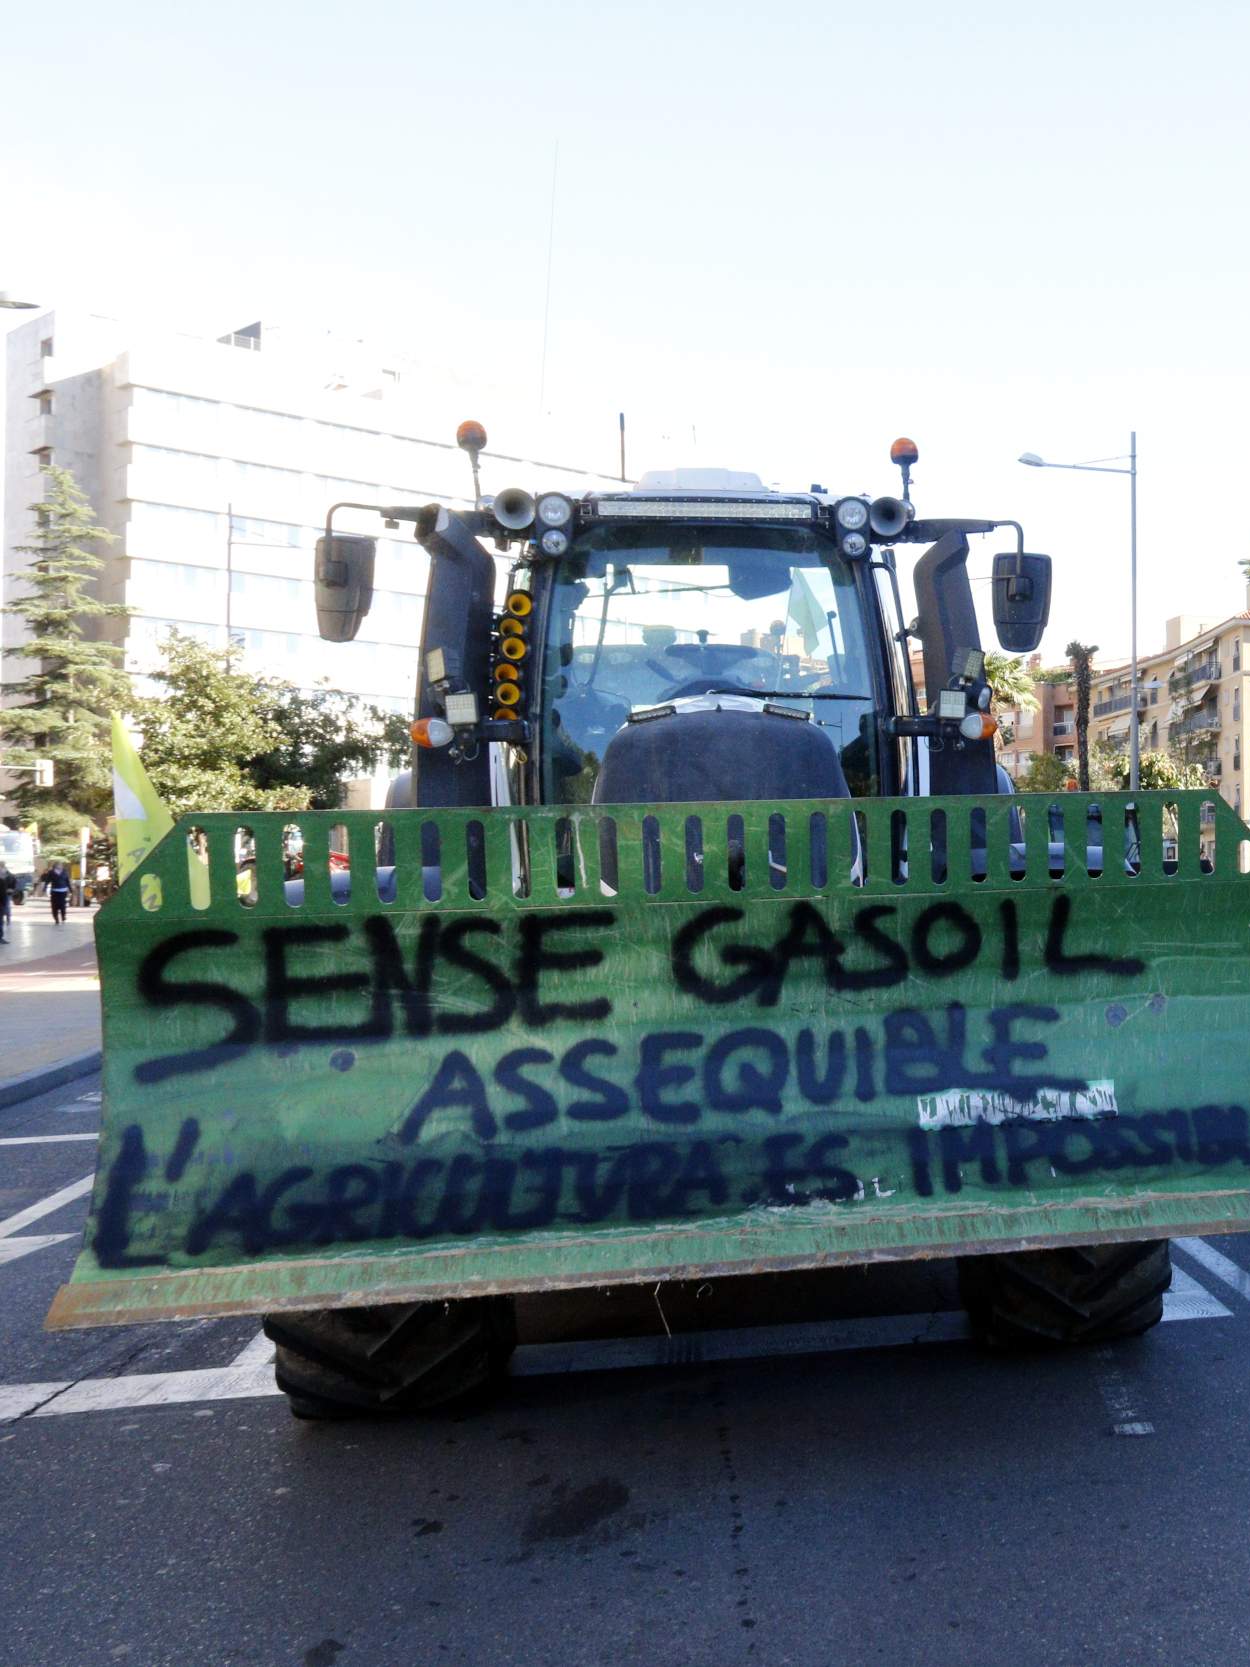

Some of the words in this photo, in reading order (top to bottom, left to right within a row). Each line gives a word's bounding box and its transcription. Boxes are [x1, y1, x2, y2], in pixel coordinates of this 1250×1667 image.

[134, 909, 616, 1084] SENSE
[672, 895, 1146, 1007] GASOIL
[398, 1003, 1090, 1144] ASSEQUIBLE
